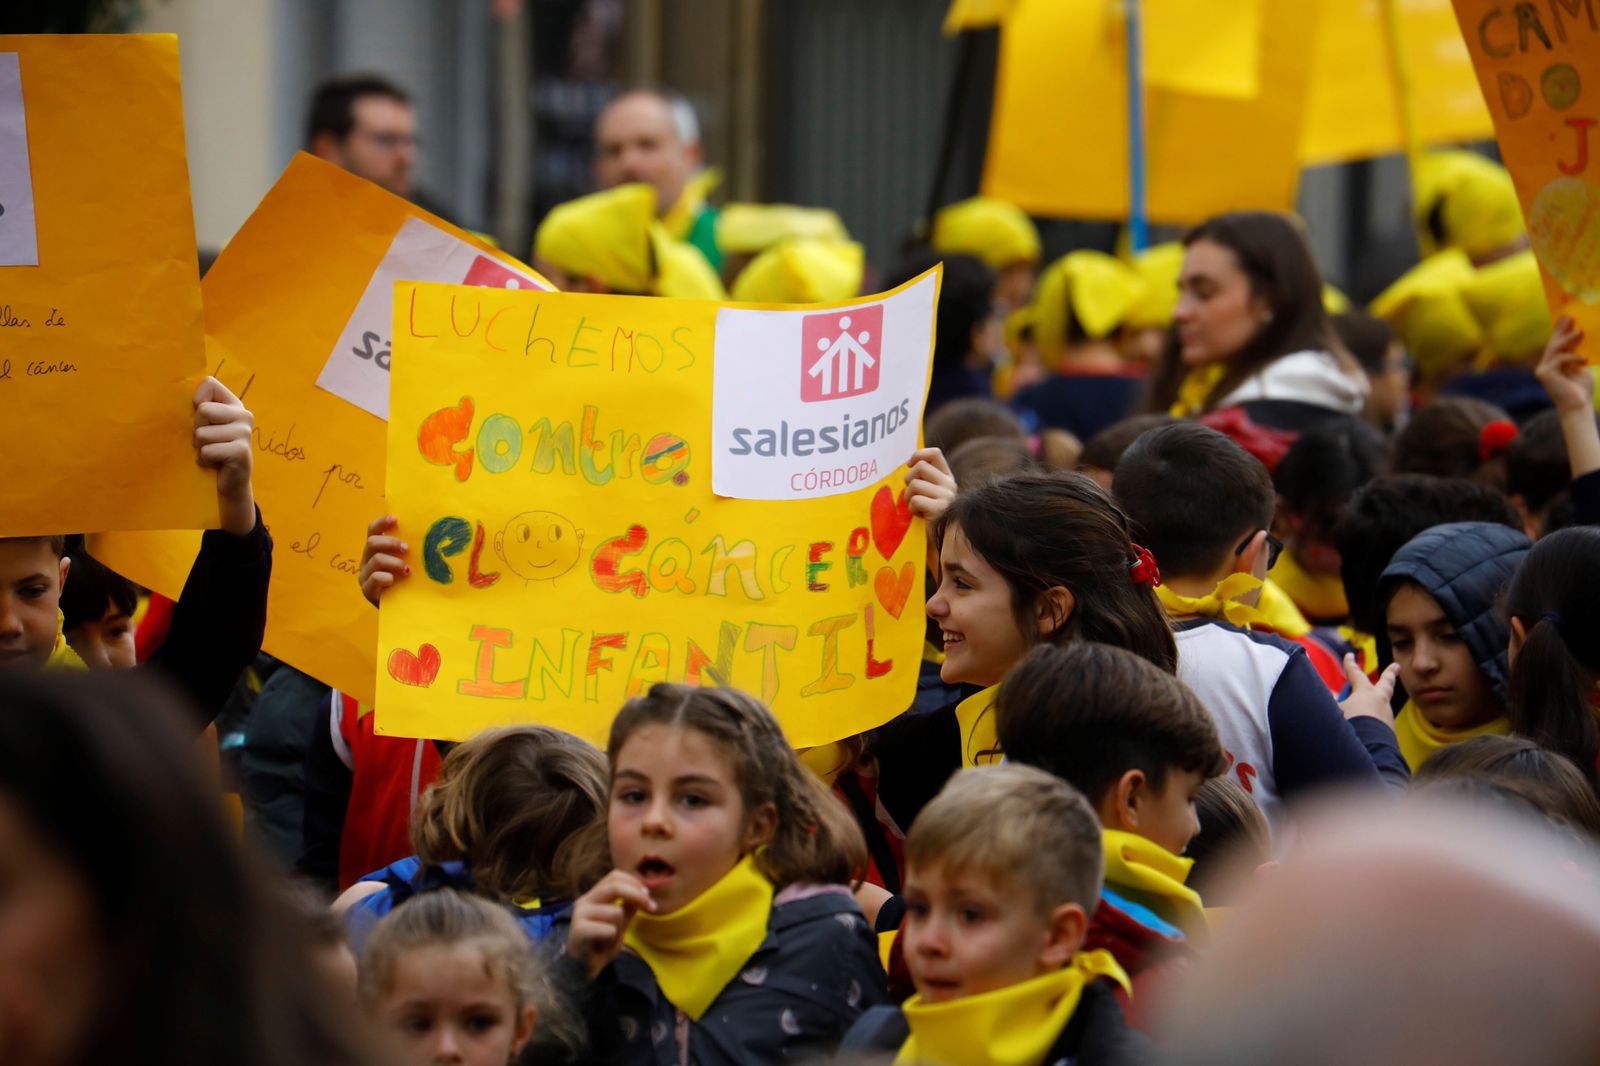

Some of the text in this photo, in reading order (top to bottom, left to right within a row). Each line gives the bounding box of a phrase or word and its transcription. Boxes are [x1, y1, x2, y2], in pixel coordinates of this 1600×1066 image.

[45, 307, 66, 327] de
[729, 397, 910, 457] salesianos
[312, 463, 364, 509] por
[790, 458, 879, 492] CÓRDOBA
[456, 602, 893, 704] INFANTIL
